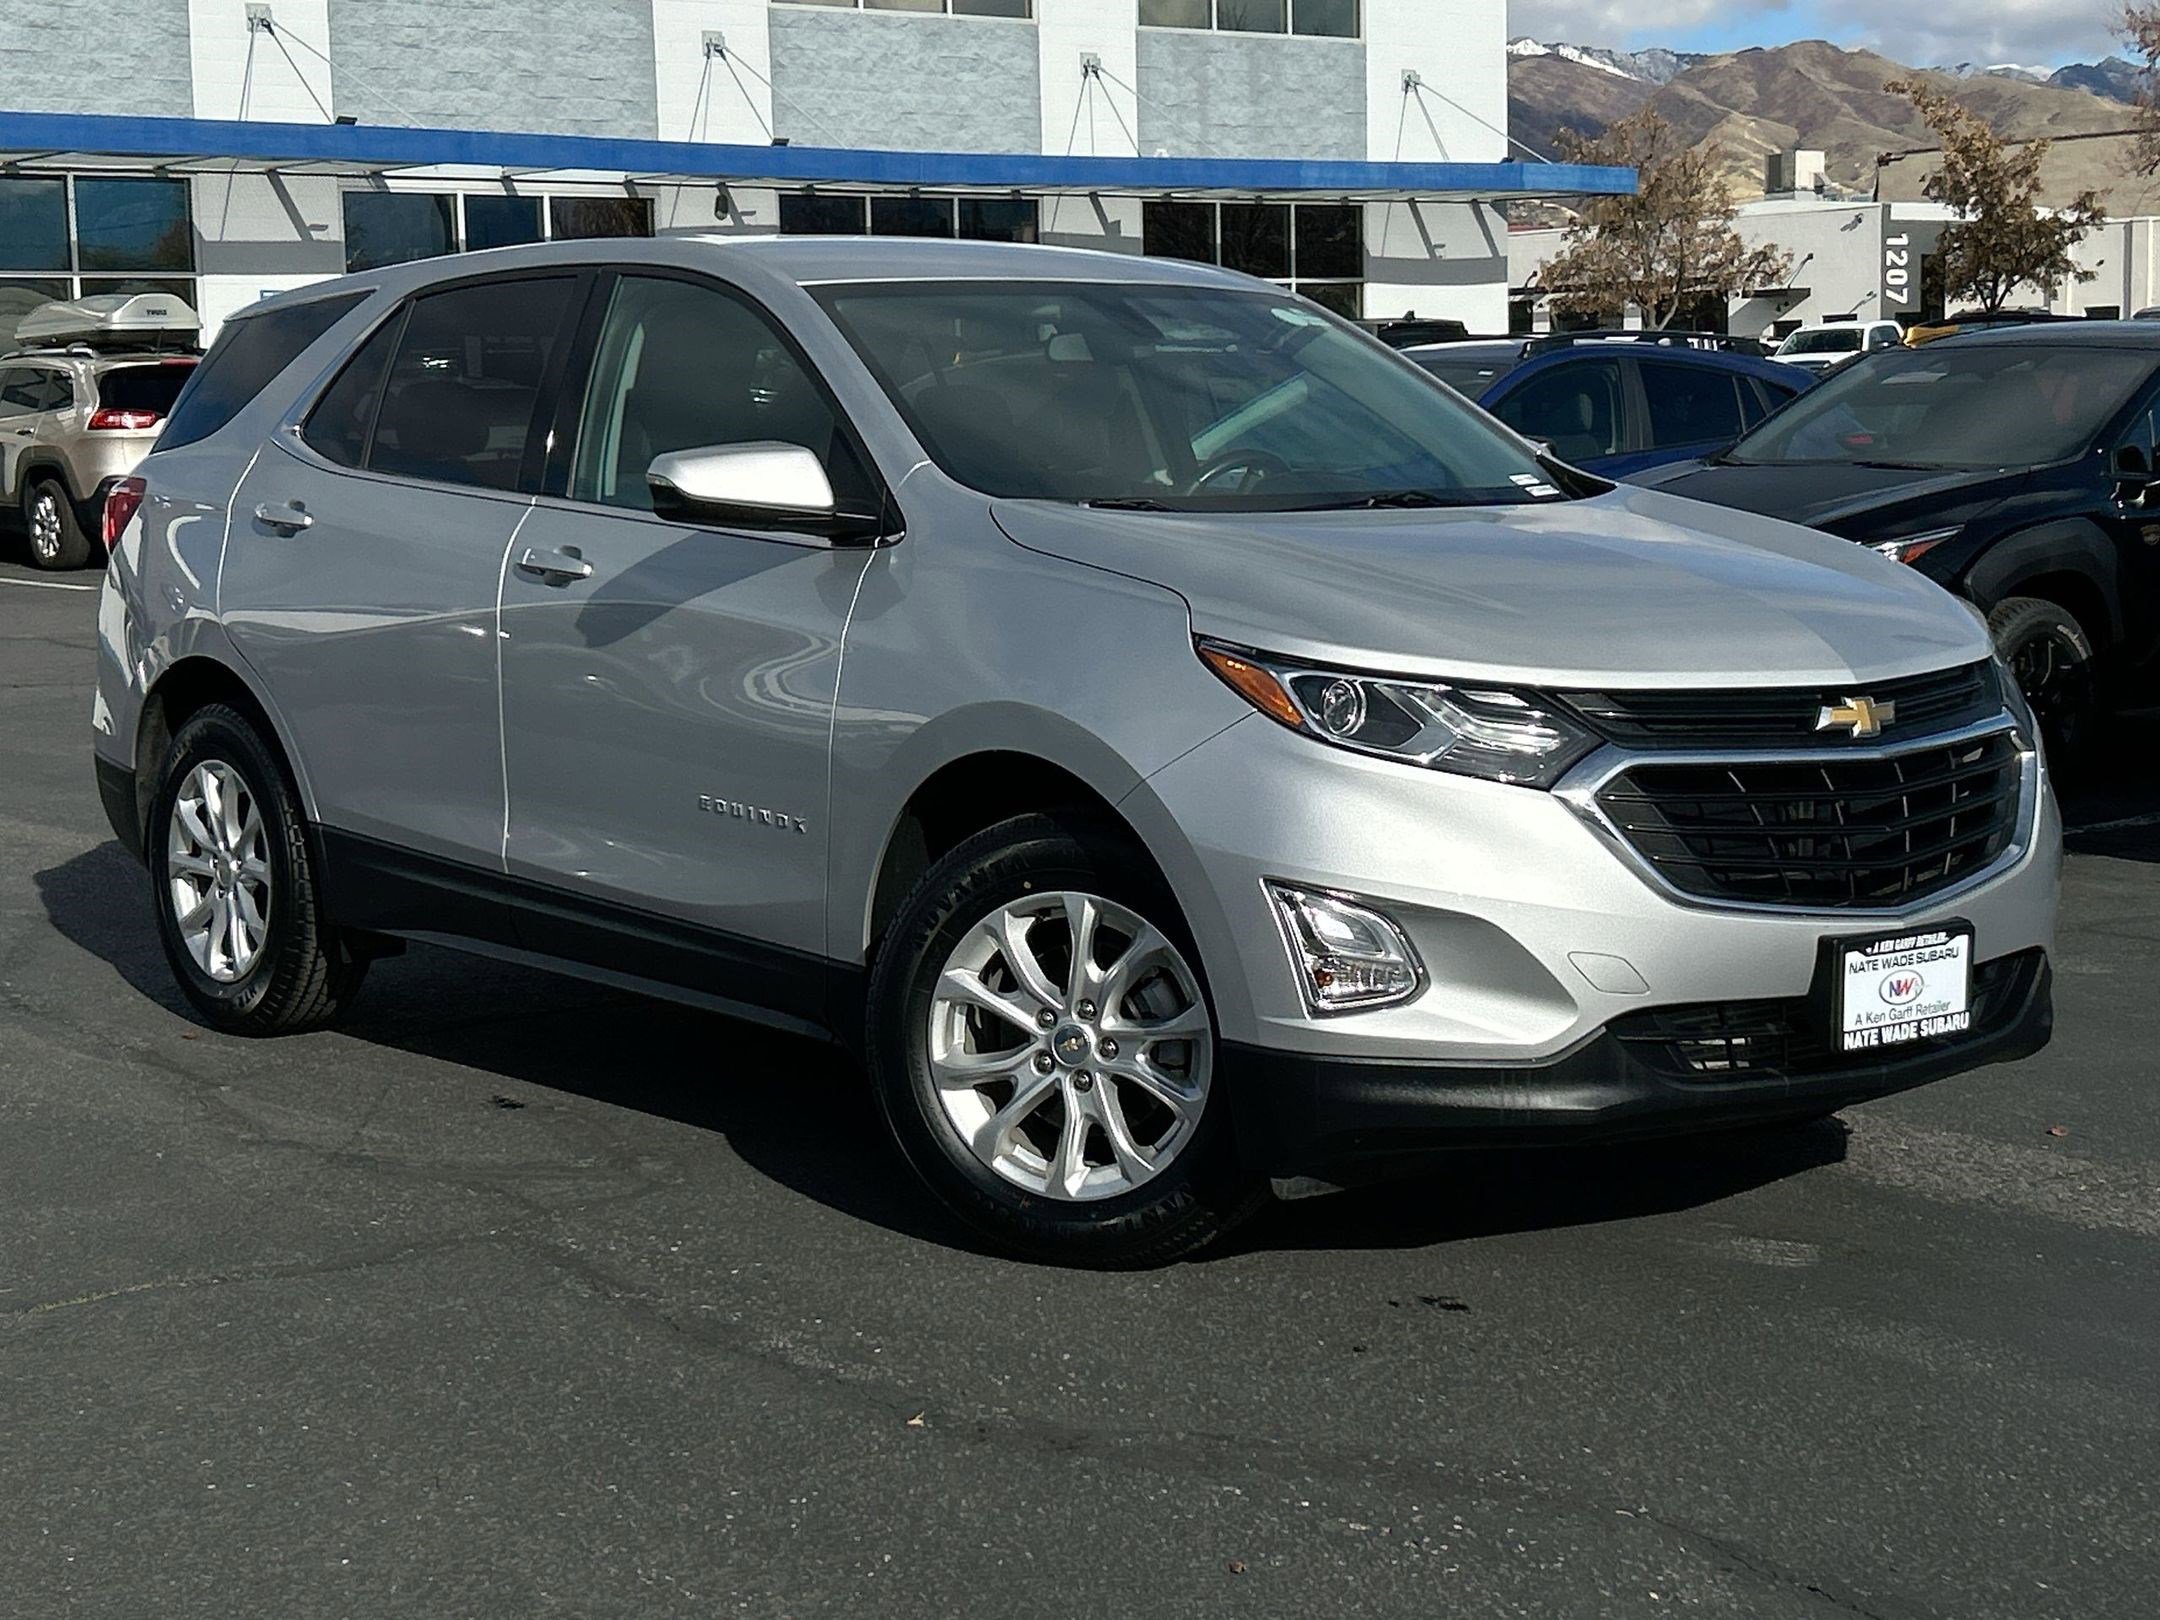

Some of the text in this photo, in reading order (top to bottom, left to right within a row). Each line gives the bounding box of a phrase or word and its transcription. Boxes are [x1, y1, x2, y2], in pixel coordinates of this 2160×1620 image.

[1885, 233, 1909, 304] 1207
[699, 794, 807, 834] EQUINOX
[1849, 946, 1960, 975] NATE WADE SUBARU
[1889, 977, 1916, 998] NW
[1844, 1011, 1970, 1051] NATE WADE SUBARU
[1855, 1013, 1863, 1026] A
[1866, 1011, 1886, 1024] Ken
[1889, 1005, 1914, 1021] Garff
